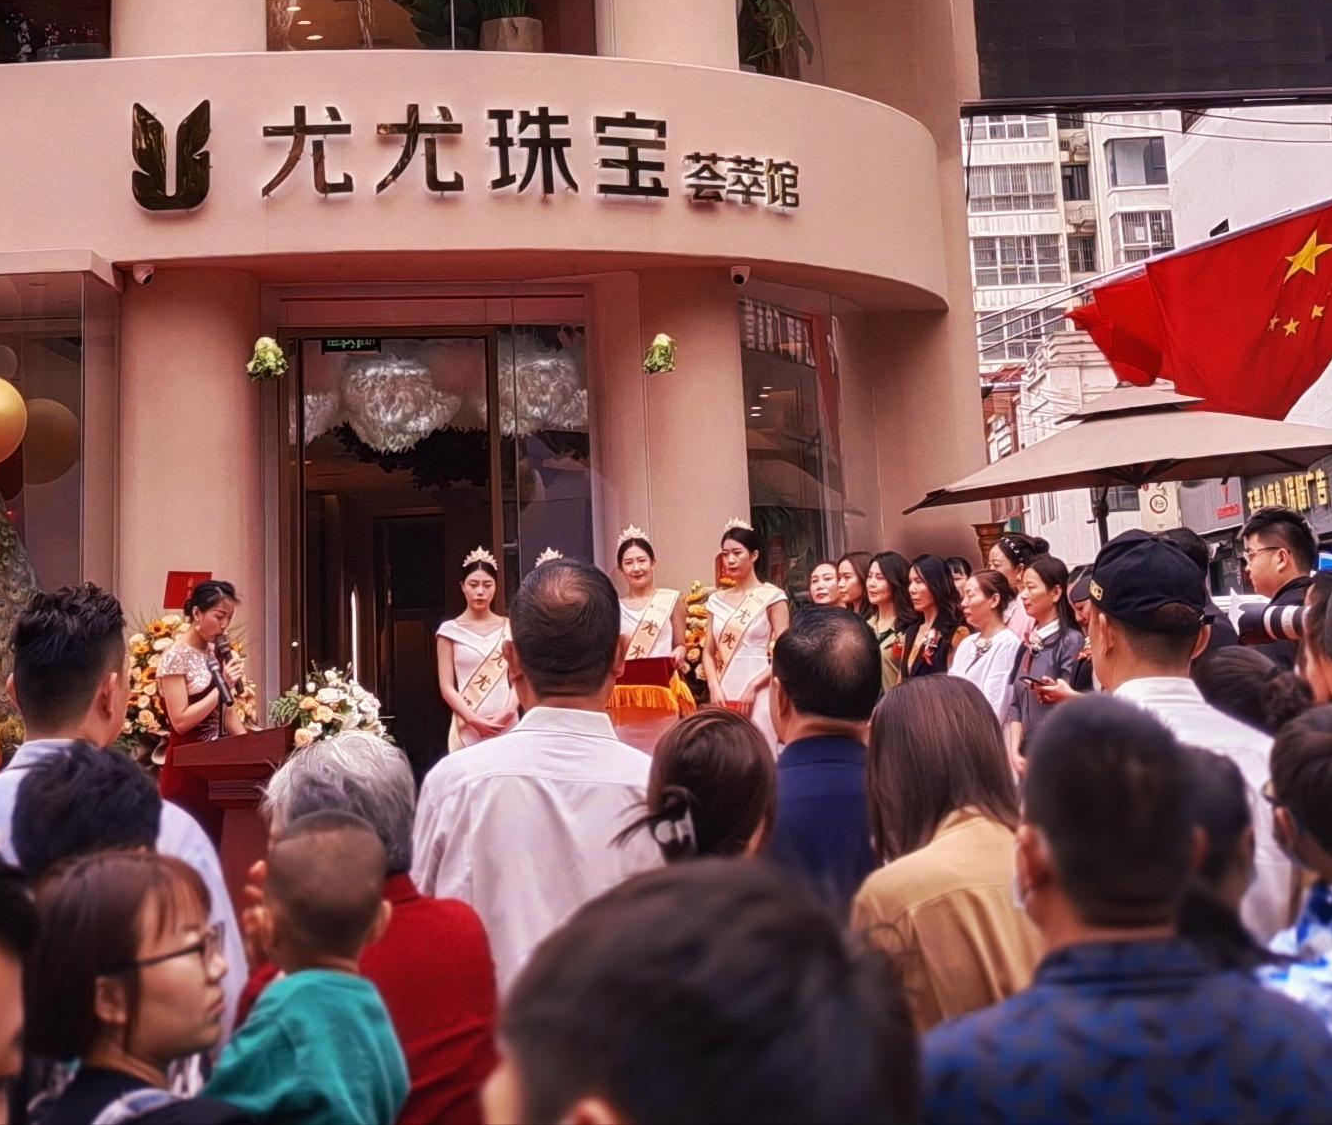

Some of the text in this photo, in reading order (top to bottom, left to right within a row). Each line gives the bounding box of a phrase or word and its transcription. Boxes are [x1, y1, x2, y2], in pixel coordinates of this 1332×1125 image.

[261, 104, 801, 210] 尤尤珠宝 荟萃馆
